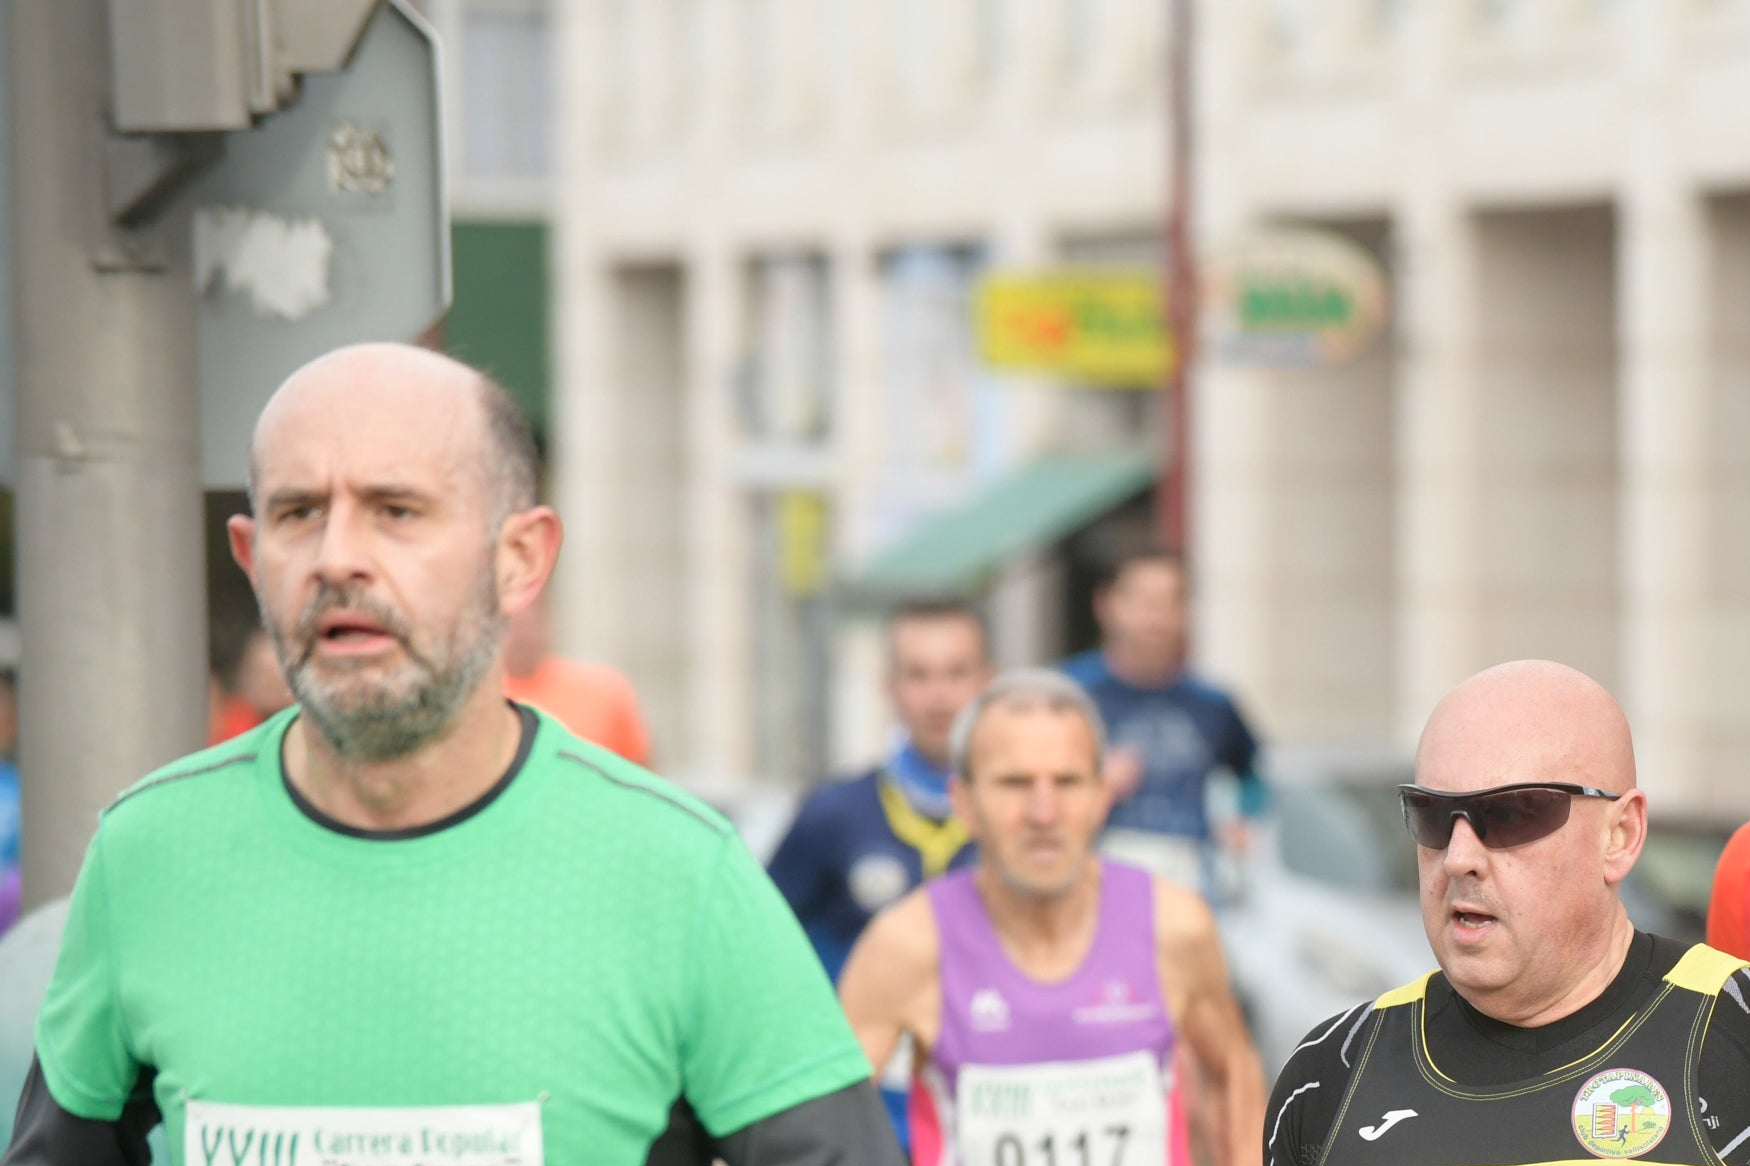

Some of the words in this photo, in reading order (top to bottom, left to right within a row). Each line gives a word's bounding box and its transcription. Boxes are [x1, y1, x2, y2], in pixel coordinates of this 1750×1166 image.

[1580, 1072, 1664, 1102] TROTAPINARES
[314, 1127, 411, 1156] Carrera
[421, 1128, 522, 1158] Popular
